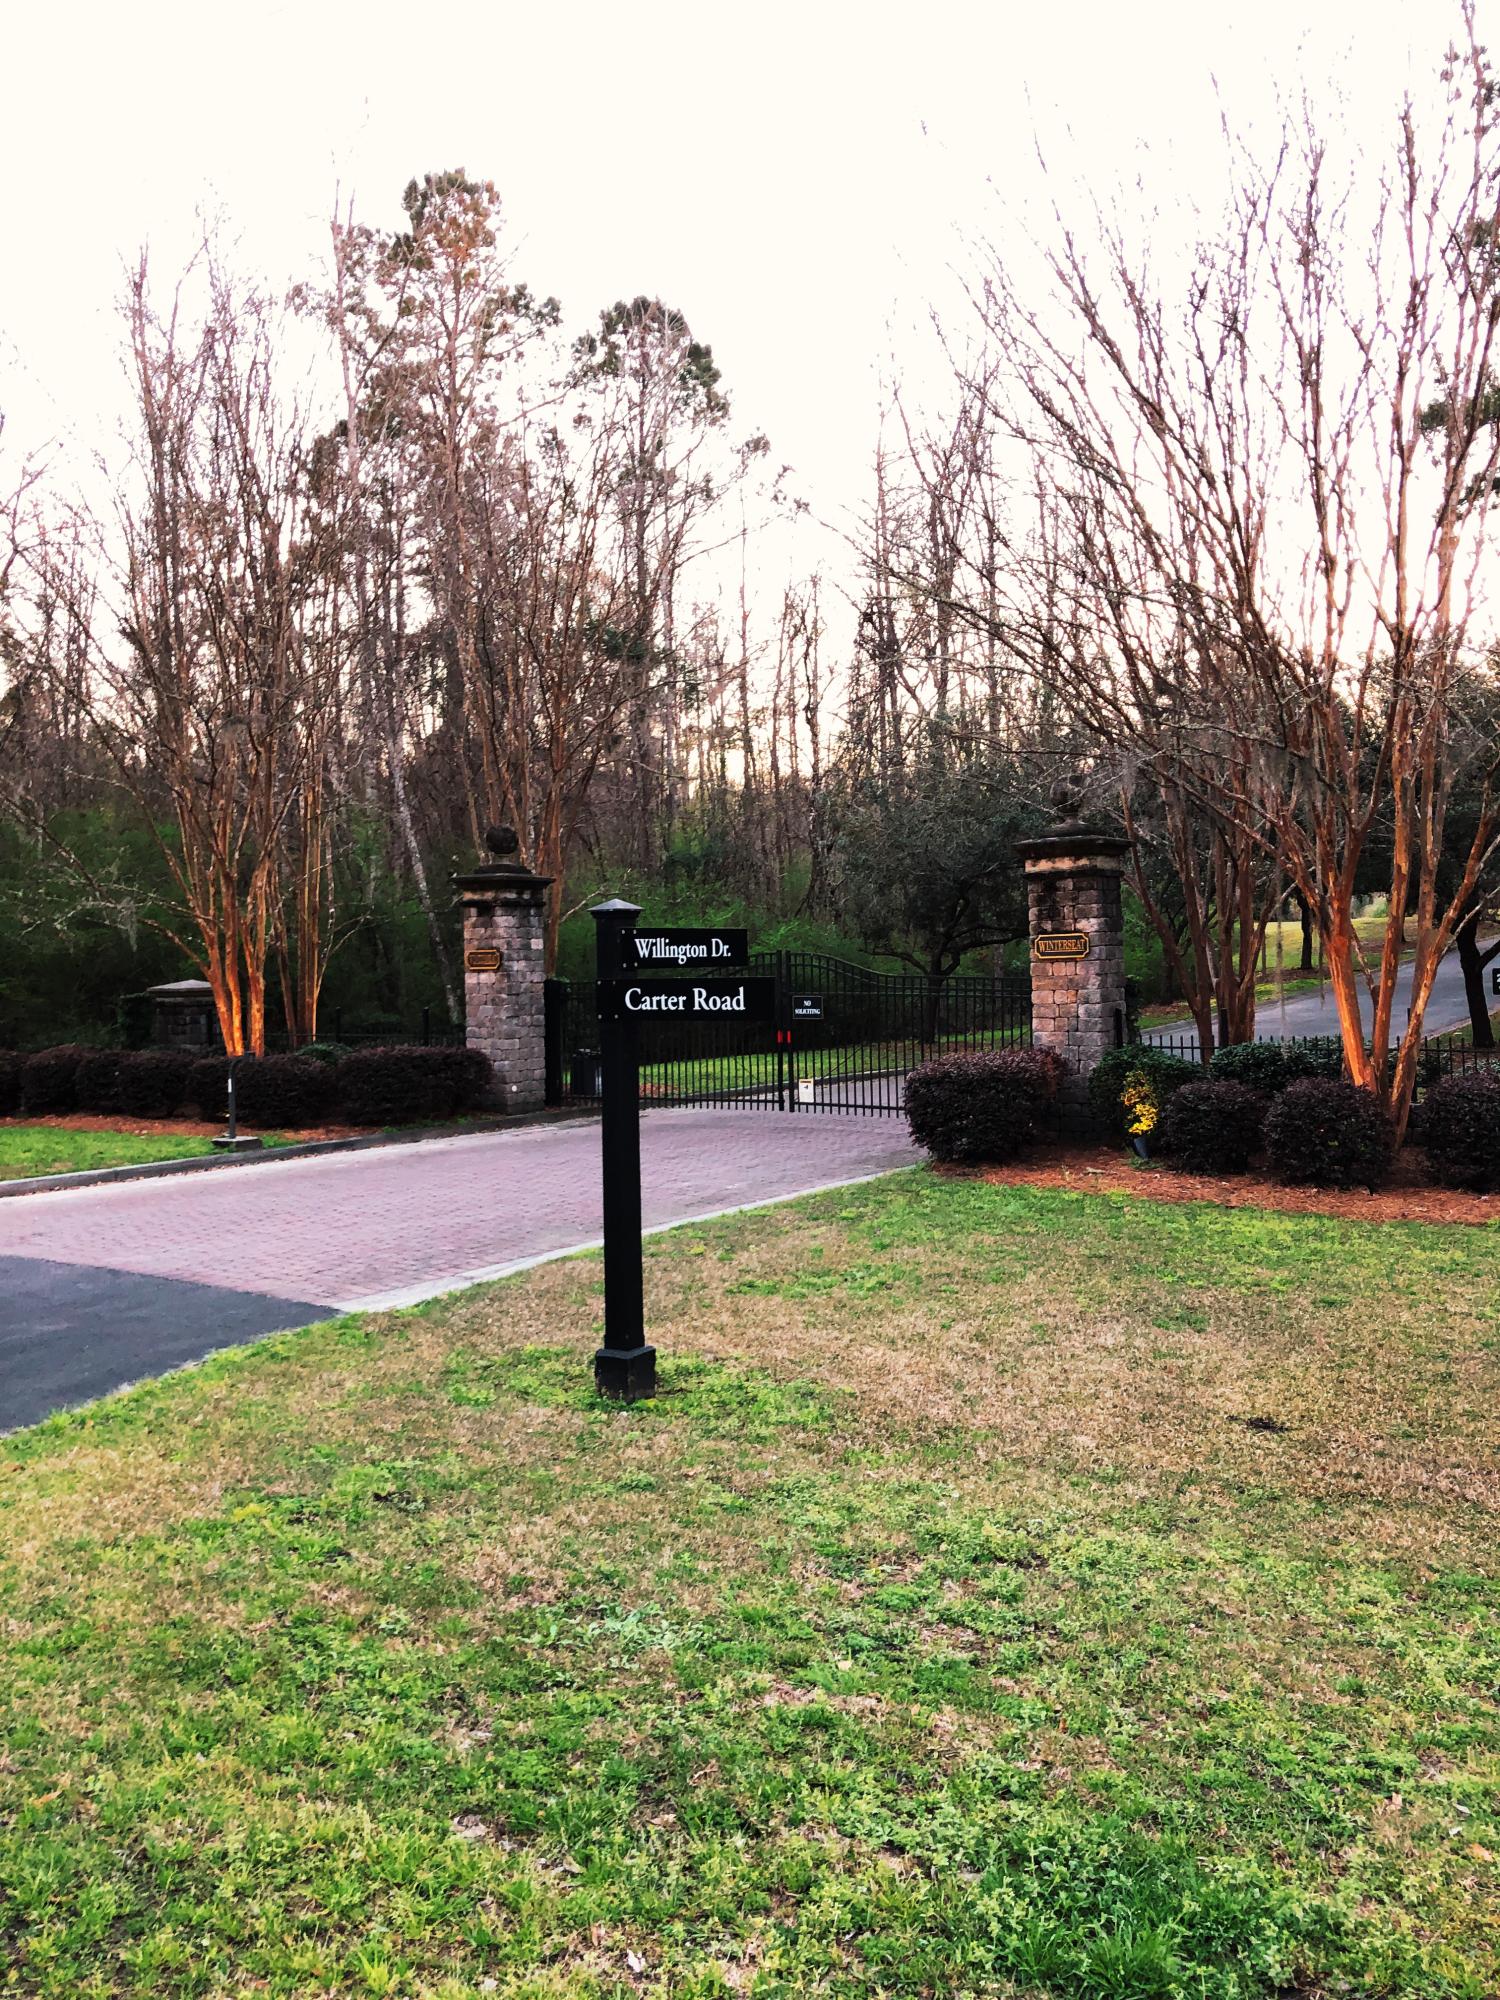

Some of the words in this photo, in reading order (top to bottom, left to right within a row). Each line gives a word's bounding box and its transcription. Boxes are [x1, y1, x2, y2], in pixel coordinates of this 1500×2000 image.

[634, 938, 708, 965] Willington
[711, 938, 732, 957] Dr.
[625, 987, 687, 1011] Carter
[692, 986, 746, 1011] Road
